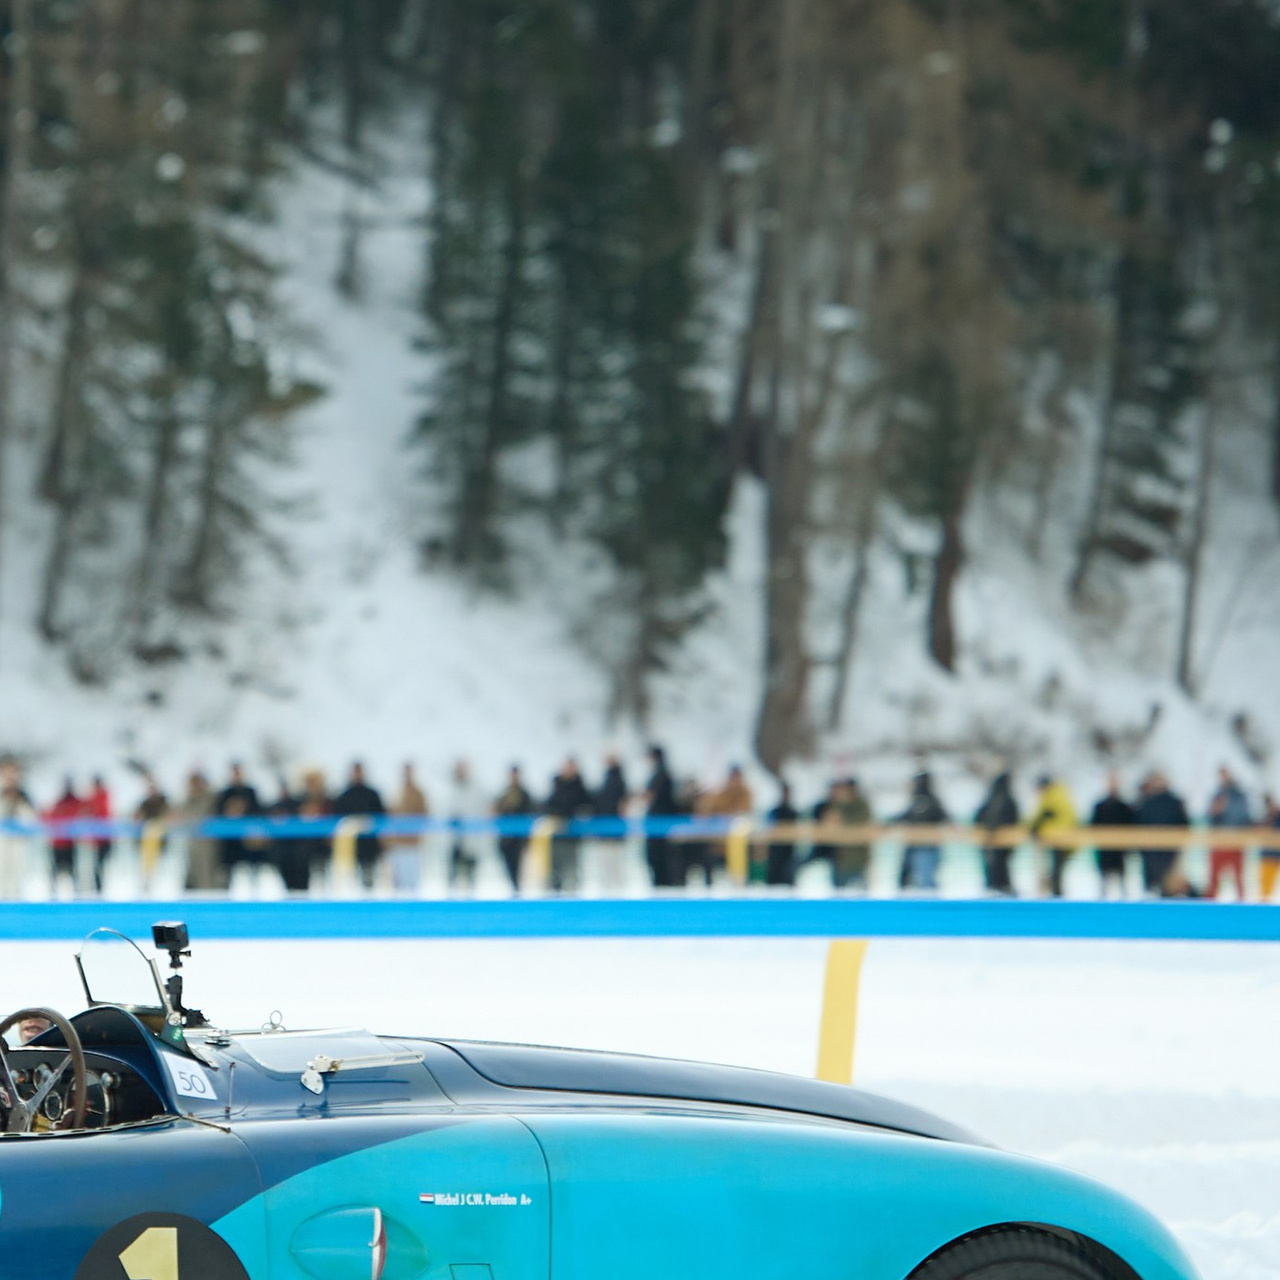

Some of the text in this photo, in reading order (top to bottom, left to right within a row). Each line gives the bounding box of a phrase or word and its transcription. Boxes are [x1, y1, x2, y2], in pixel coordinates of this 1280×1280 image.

[178, 1071, 206, 1094] 50
[435, 1193, 459, 1205] Michel
[485, 1193, 517, 1205] Perridon
[520, 1193, 532, 1205] A+
